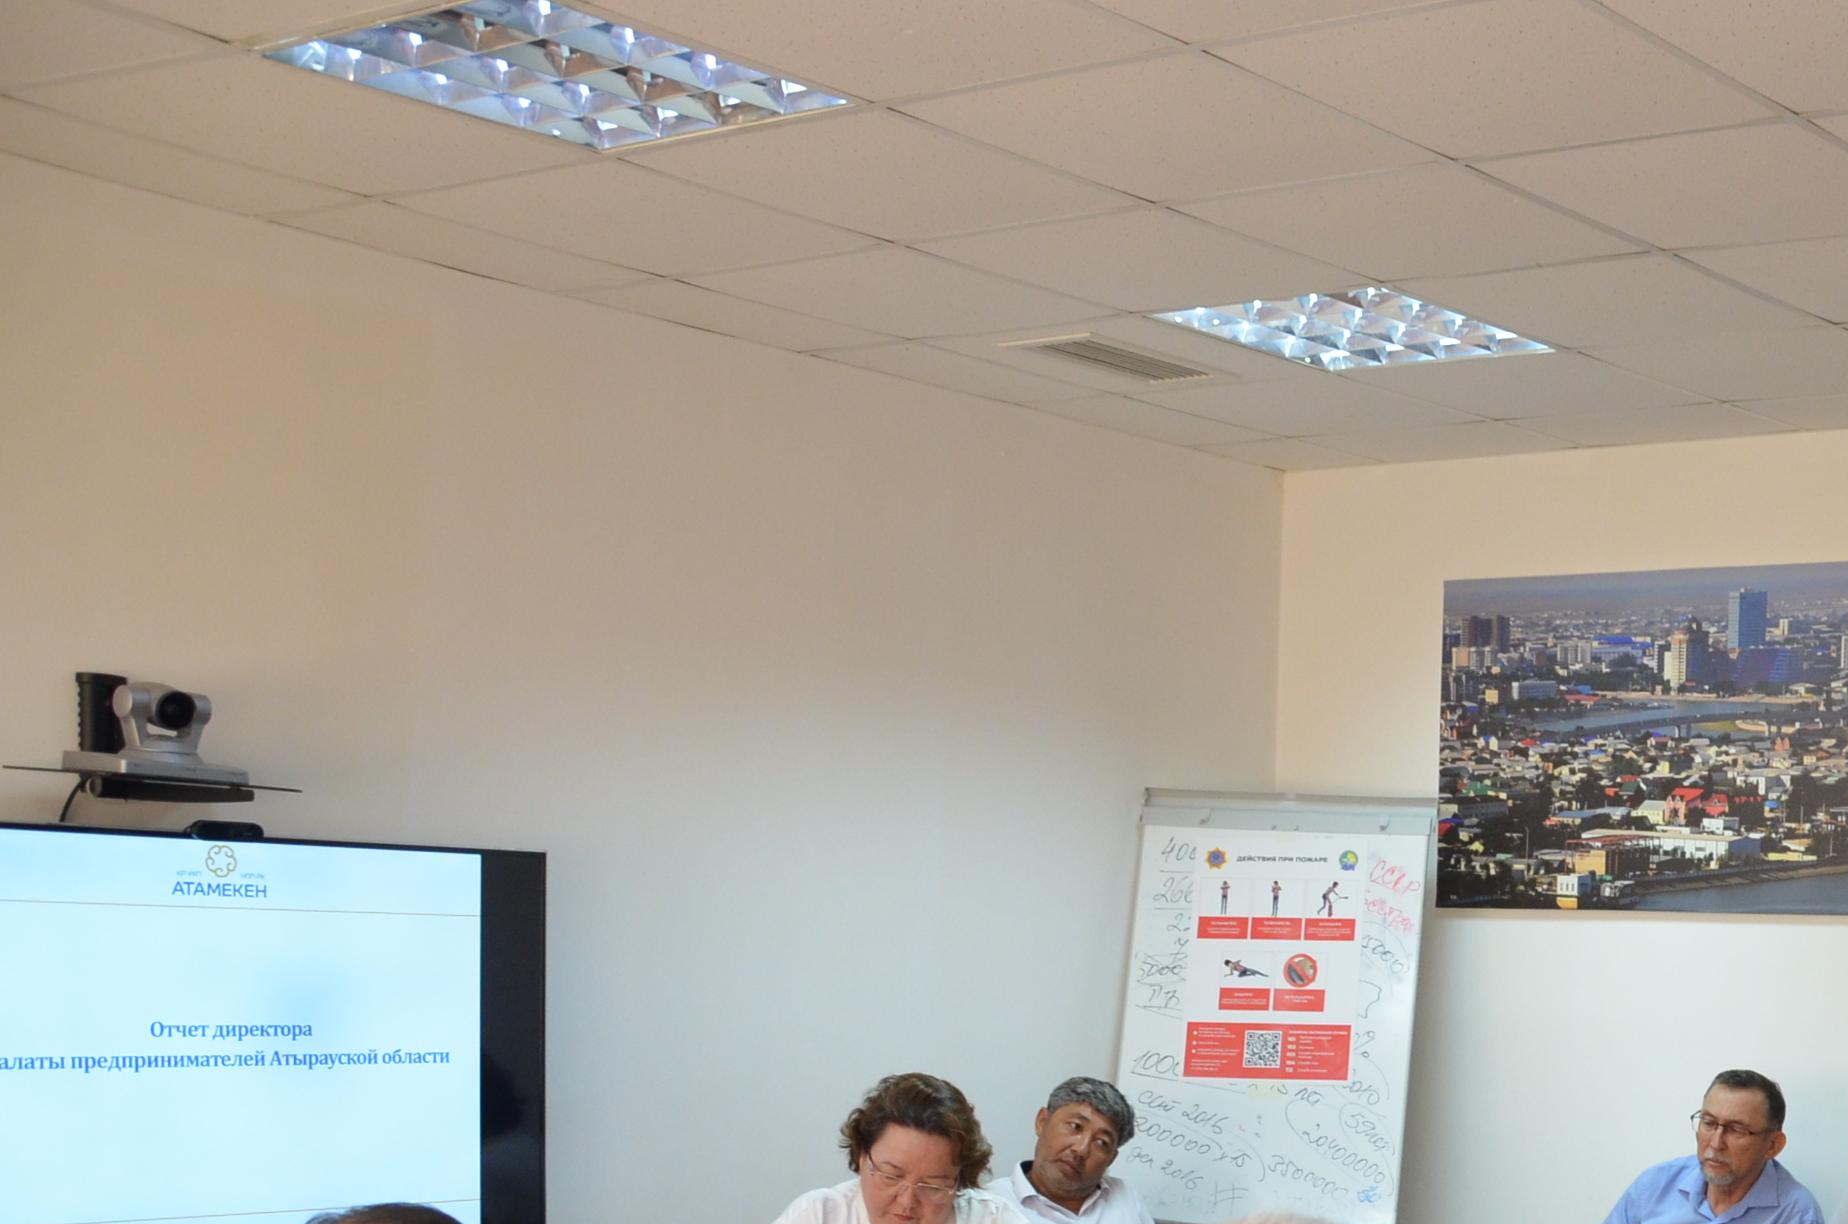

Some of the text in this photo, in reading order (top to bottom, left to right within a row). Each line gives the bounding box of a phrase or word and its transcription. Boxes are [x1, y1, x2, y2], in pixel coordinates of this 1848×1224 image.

[1236, 855, 1277, 863] ДЕЙСТВИЯ
[171, 881, 267, 898] АТАМЕКЕН
[150, 1021, 312, 1041] Отчет директора
[0, 1048, 450, 1073] алаты предпринимателей Атырауской области
